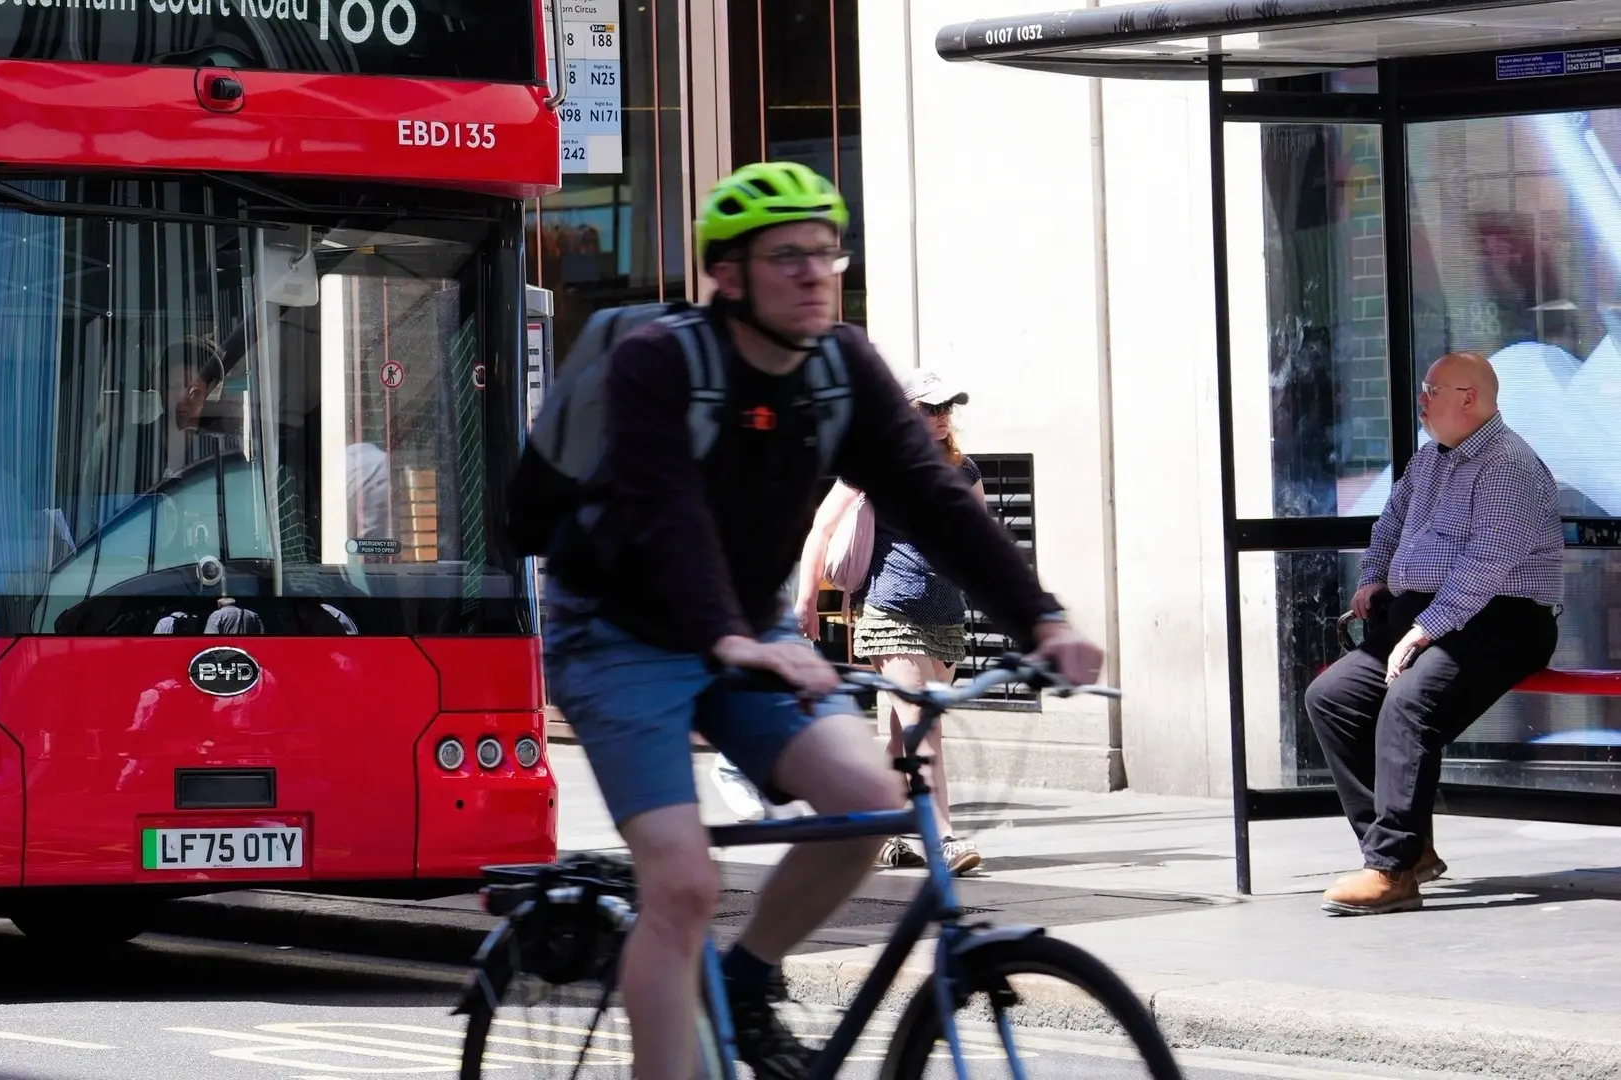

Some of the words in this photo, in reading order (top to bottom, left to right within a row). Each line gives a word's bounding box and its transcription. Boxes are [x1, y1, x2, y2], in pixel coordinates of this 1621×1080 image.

[593, 34, 612, 47] 188
[985, 27, 1014, 45] 0107
[1017, 24, 1043, 41] 1032
[591, 72, 615, 86] N25
[559, 109, 581, 122] N98
[590, 110, 618, 122] N171
[397, 120, 497, 150] EBD135
[561, 148, 585, 160] 242
[198, 663, 253, 681] BYD
[161, 833, 235, 863] LF75
